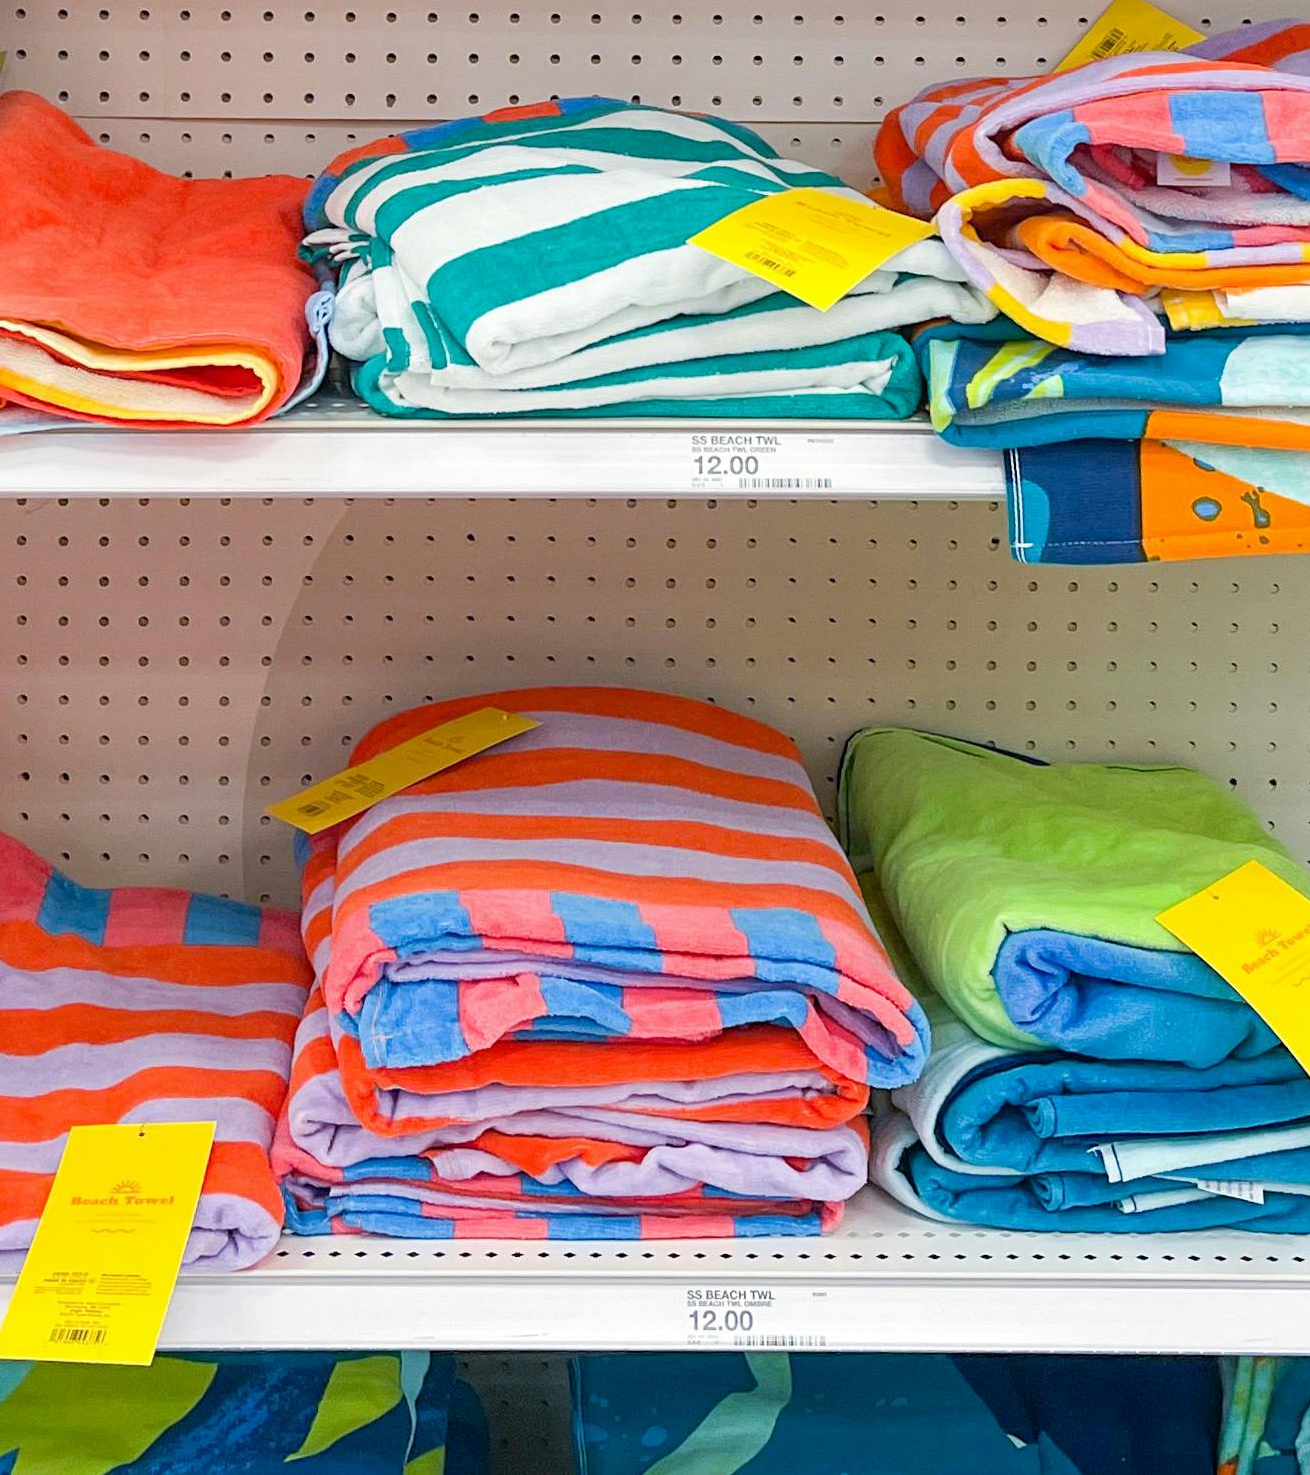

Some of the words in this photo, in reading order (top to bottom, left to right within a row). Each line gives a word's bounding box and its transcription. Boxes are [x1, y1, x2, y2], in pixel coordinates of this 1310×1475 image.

[692, 435, 707, 445] SS
[711, 435, 752, 445] BEACH
[756, 435, 782, 445] TWL
[693, 455, 759, 475] 12.00
[1241, 949, 1280, 974] Beach
[70, 1196, 120, 1206] Beach
[124, 1195, 176, 1206] Towel
[687, 1290, 702, 1300] SS
[706, 1290, 747, 1300] BEACH
[750, 1290, 776, 1300] TWL
[689, 1310, 754, 1332] 12.00
